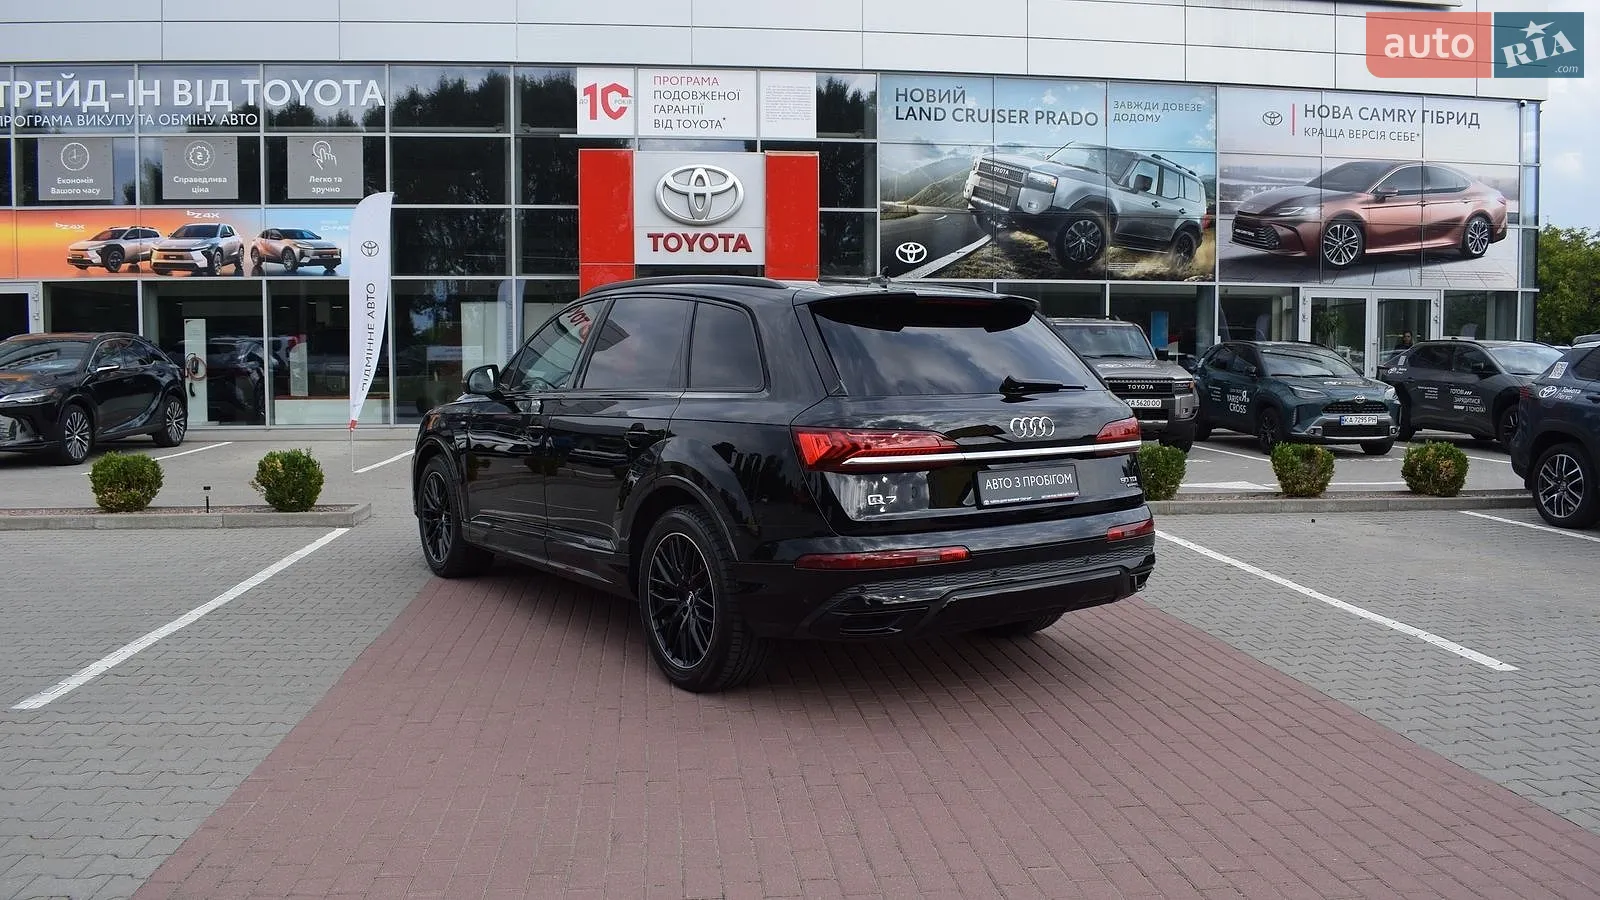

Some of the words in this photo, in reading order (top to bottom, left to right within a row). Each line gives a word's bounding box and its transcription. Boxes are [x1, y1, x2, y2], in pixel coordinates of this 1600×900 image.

[653, 75, 719, 86] ПРОГРАМА
[174, 79, 232, 112] ВІД
[241, 79, 385, 106] TOYOTA
[653, 89, 741, 101] ПОДОВЖЕНОЇ
[895, 85, 966, 104] НОВИЙ
[653, 103, 704, 115] ГАРАНТІЇ
[1113, 101, 1159, 111] ЗАВЖДИ
[1161, 103, 1203, 112] ДОВЕЗЕ
[77, 114, 135, 127] ВИКУПУ
[139, 113, 155, 126] ТА
[159, 113, 216, 126] ОБМІНУ
[220, 113, 258, 126] АВТО
[895, 105, 946, 122] LAND
[952, 107, 1029, 124] CRUISER
[1035, 110, 1099, 126] PRADO
[1112, 113, 1160, 123] ДОДОМУ
[1304, 104, 1354, 120] НОВА
[1358, 107, 1417, 123] CAMRY
[1421, 110, 1480, 129] ГІБРИД
[653, 118, 673, 130] ВІД
[1304, 128, 1345, 140] КРАЩА
[1348, 130, 1386, 141] ВЕРСІЯ
[57, 177, 94, 185] Економія
[173, 176, 228, 184] Справедлива
[51, 187, 80, 195] Вашого
[82, 187, 101, 196] часу
[191, 186, 210, 194] ціна
[647, 232, 752, 253] TOYOTA
[366, 282, 376, 319] АВТО
[1136, 399, 1150, 407] 5620
[985, 477, 1013, 490] АВТО
[1023, 473, 1073, 487] ПРОБІГОМ
[868, 495, 897, 506] Q7
